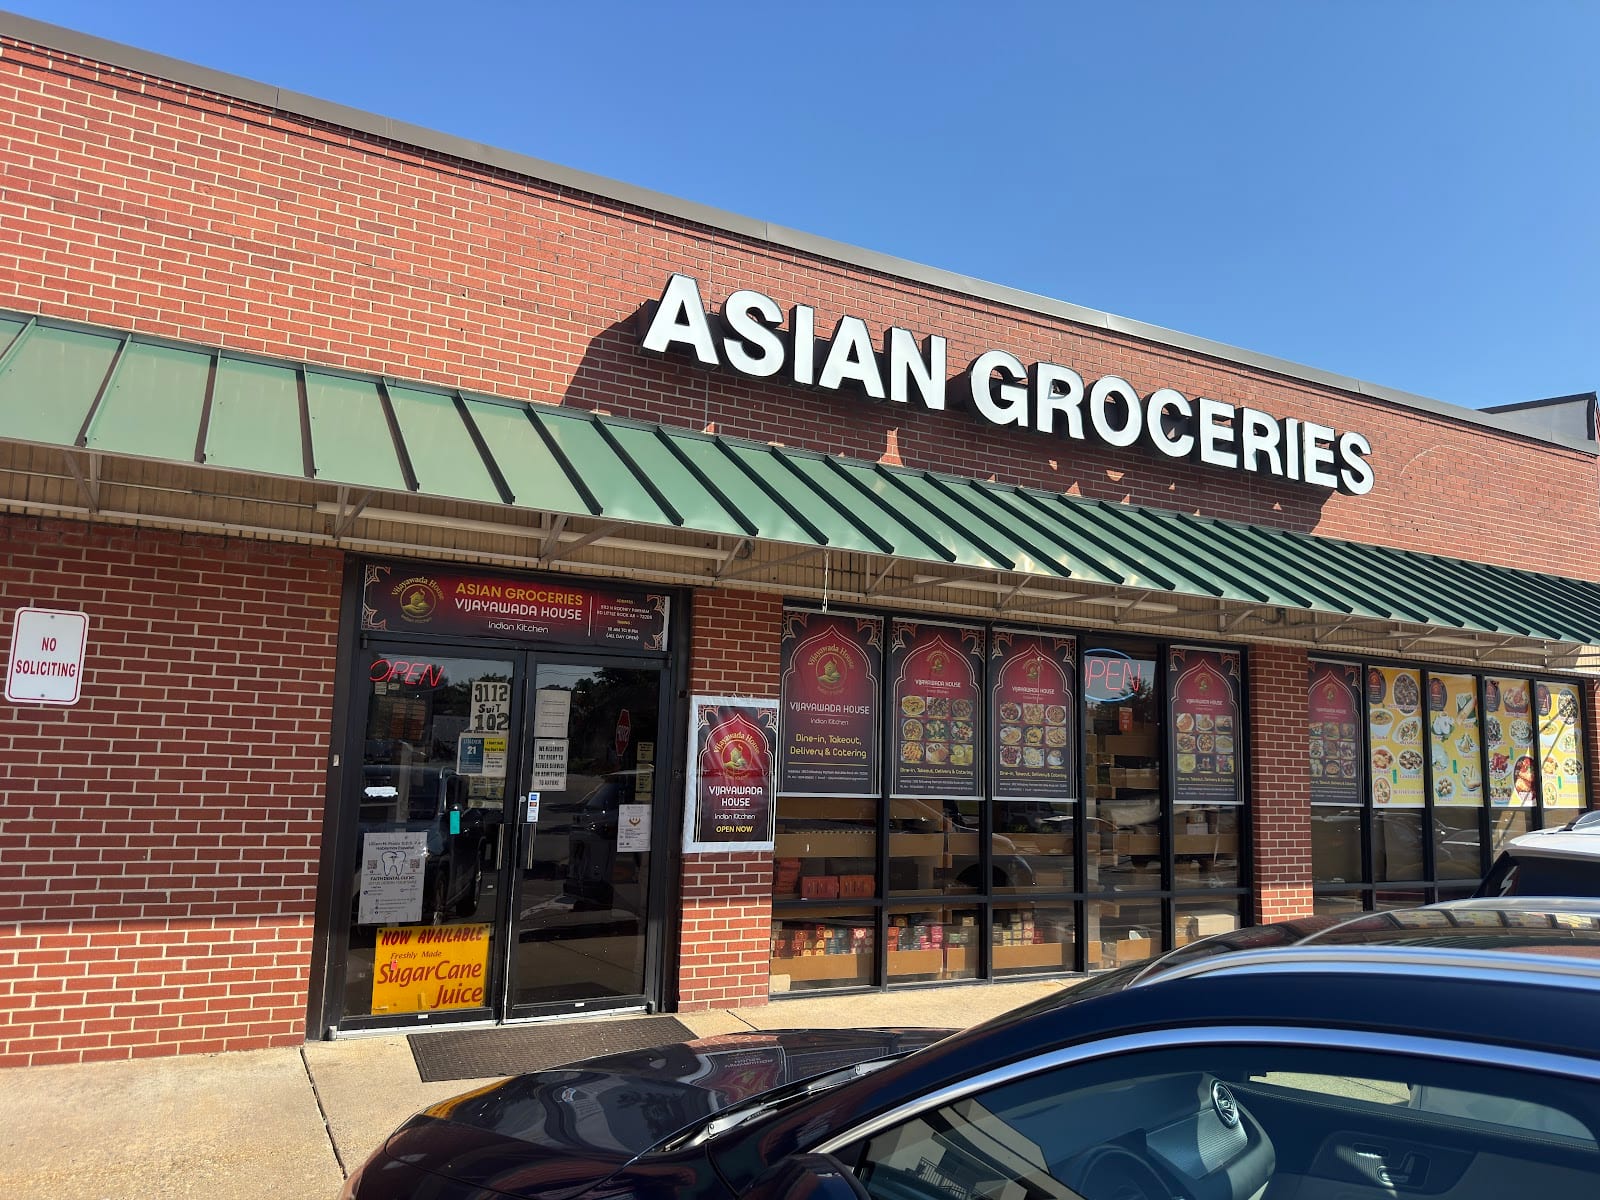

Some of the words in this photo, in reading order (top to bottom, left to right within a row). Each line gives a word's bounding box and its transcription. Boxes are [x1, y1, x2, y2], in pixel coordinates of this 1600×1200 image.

[642, 273, 946, 411] ASIAN
[970, 349, 1375, 496] GROCERIES
[456, 582, 501, 598] ASIAN
[505, 587, 583, 606] GROCERIES
[455, 598, 537, 616] VIJAYAWADA
[541, 606, 582, 620] HOUSE
[488, 620, 514, 631] Indian
[516, 623, 549, 633] Kitchen
[41, 637, 57, 652] NO
[15, 659, 76, 678] SOLICITING
[369, 658, 445, 687] OPEN
[790, 701, 841, 712] VIJAYAWADA
[843, 704, 870, 715] HOUSE
[474, 712, 509, 731] 102
[714, 731, 745, 753] Vijayawada
[795, 733, 827, 745] Dine-in,
[829, 735, 862, 746] Takeout,
[467, 745, 477, 755] 21
[790, 746, 823, 757] Delivery
[824, 747, 831, 756] &
[832, 748, 867, 759] Catering
[709, 786, 763, 796] VIJAYAWADA
[721, 798, 751, 806] HOUSE
[381, 930, 413, 946] NOW
[418, 926, 485, 944] AVAILABLE
[390, 952, 418, 960] Freshly
[421, 950, 442, 958] Made
[430, 982, 483, 1009] Juice
